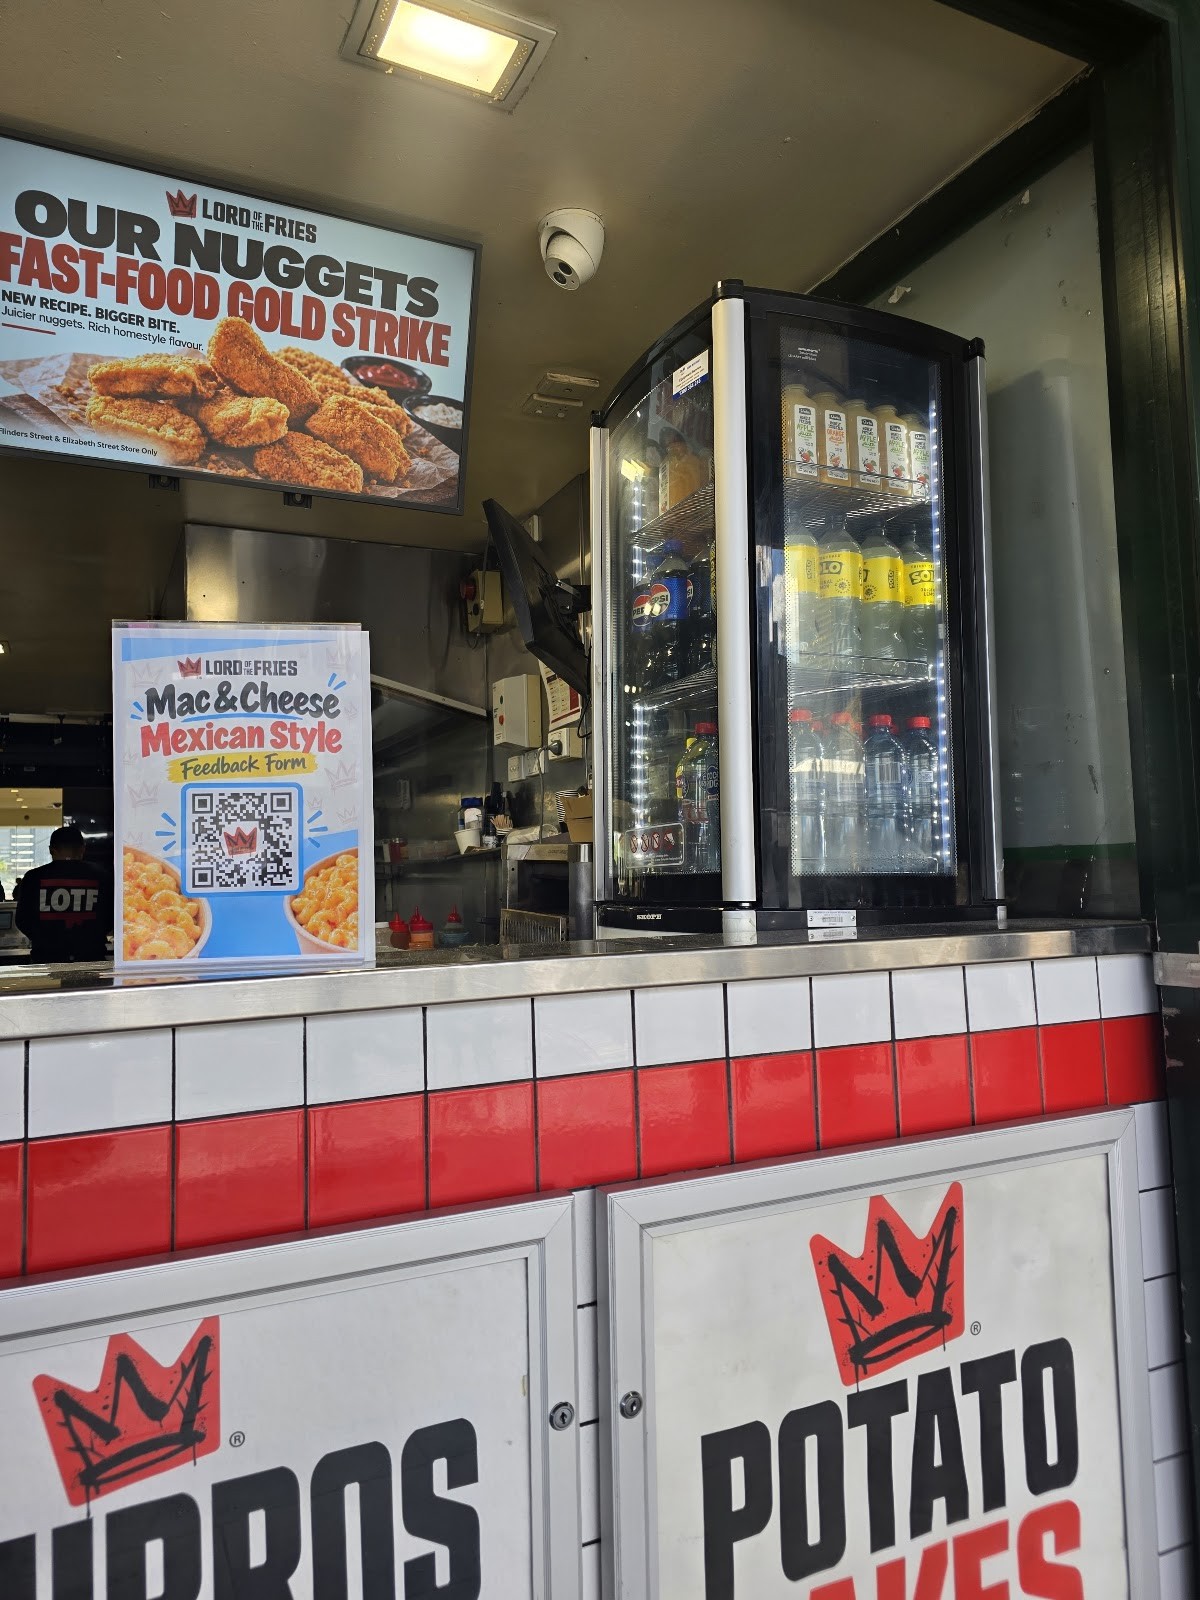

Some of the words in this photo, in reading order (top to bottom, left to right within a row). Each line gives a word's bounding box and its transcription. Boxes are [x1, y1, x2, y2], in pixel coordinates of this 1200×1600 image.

[202, 198, 250, 228] LORD
[251, 220, 263, 232] THE
[252, 210, 263, 221] OF
[264, 213, 317, 244] FRIES
[15, 189, 162, 262] OUR
[173, 221, 440, 318] NUGGETS
[0, 231, 220, 321] FAST-FOOD
[227, 280, 327, 341] GOLD
[331, 302, 452, 367] STRIKE
[1, 289, 37, 306] NEW
[39, 296, 92, 318] RECIPE.
[95, 306, 145, 328] BIGGER
[148, 317, 181, 334] BITE.
[1, 305, 37, 321] Juicier
[39, 312, 86, 331] nuggets.
[88, 321, 111, 334] Rich
[113, 326, 167, 345] homestyle
[168, 336, 204, 351] flavour.
[29, 431, 53, 442] Street
[54, 435, 61, 443] &
[62, 436, 96, 448] Elizabeth
[97, 441, 120, 451] Street
[120, 444, 140, 454] Store
[141, 447, 158, 457] Only
[205, 659, 242, 676] LORD
[243, 668, 253, 676] THE
[244, 660, 252, 668] OF
[253, 660, 298, 676] FRIES
[145, 683, 211, 722] Mac
[214, 680, 238, 714] &
[240, 681, 341, 720] Cheese
[140, 721, 265, 758] Mexican
[269, 720, 343, 754] Style
[180, 755, 260, 780] Feedback
[264, 752, 308, 773] Form
[39, 887, 99, 912] LOTF
[701, 1337, 1079, 1600] POTATO
